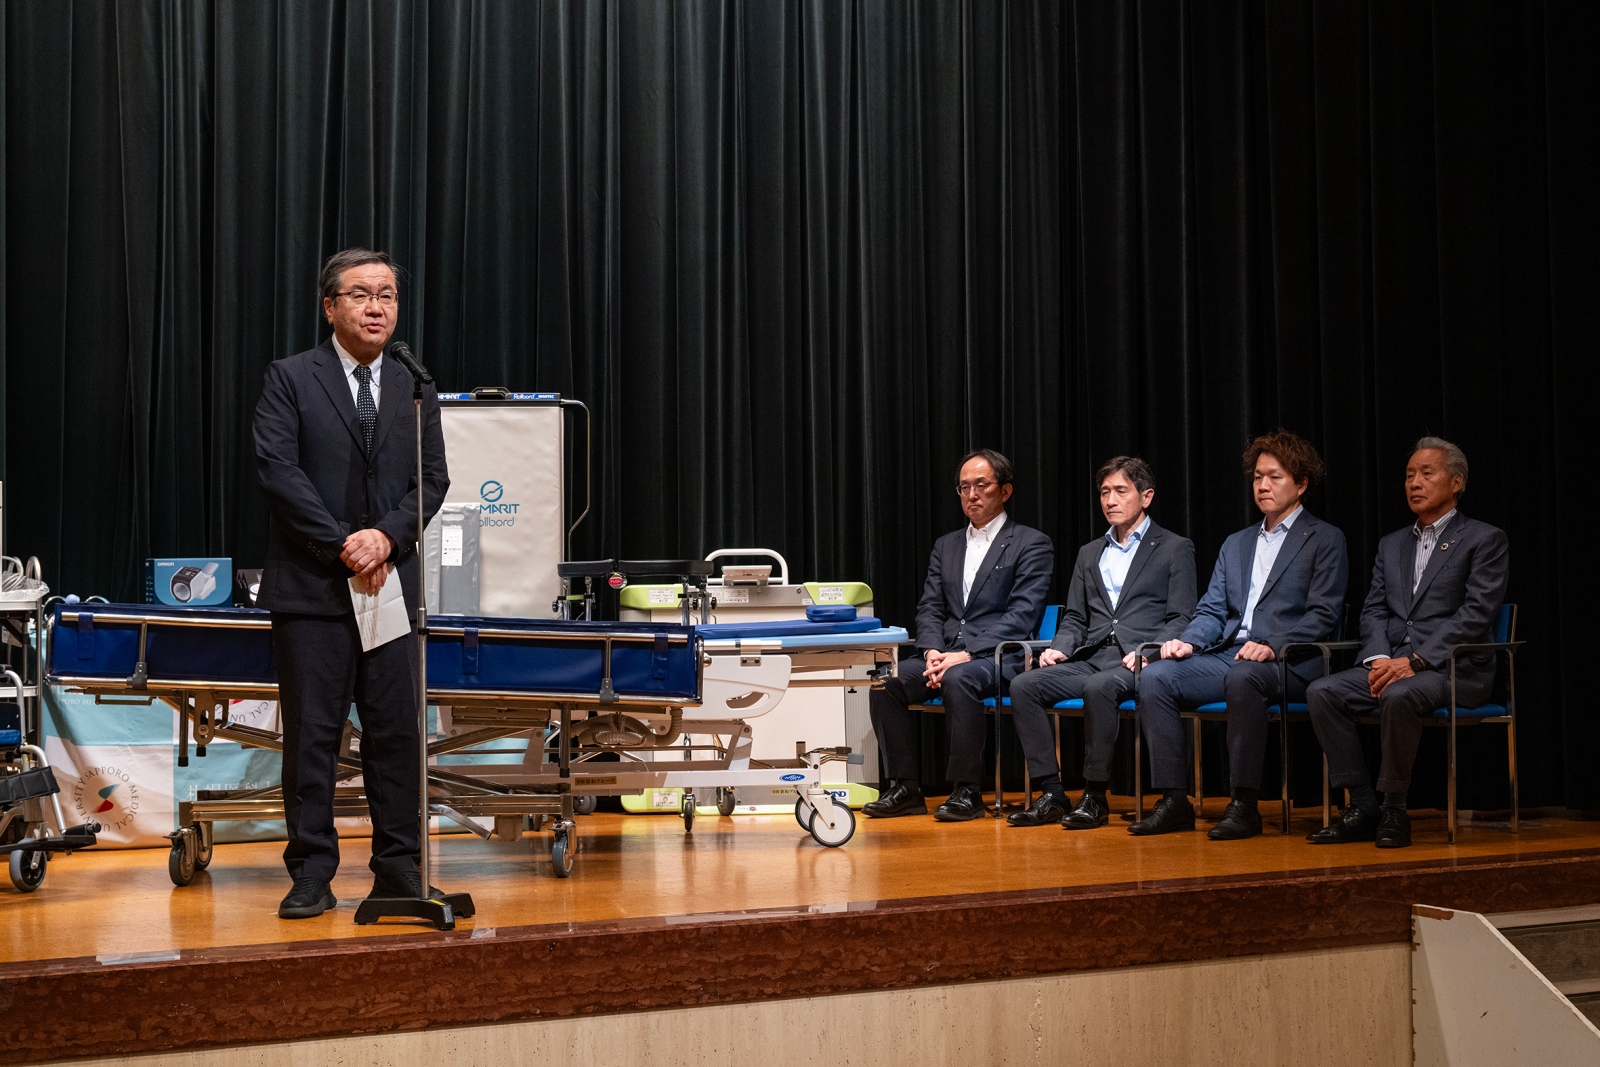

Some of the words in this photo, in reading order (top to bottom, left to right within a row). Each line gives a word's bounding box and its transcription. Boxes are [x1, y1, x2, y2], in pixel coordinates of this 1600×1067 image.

[480, 503, 520, 514] MARIT
[479, 517, 515, 527] ollbord
[84, 766, 130, 783] SAPPORO
[74, 777, 111, 832] UVERSITY
[114, 784, 140, 830] MEDICAL
